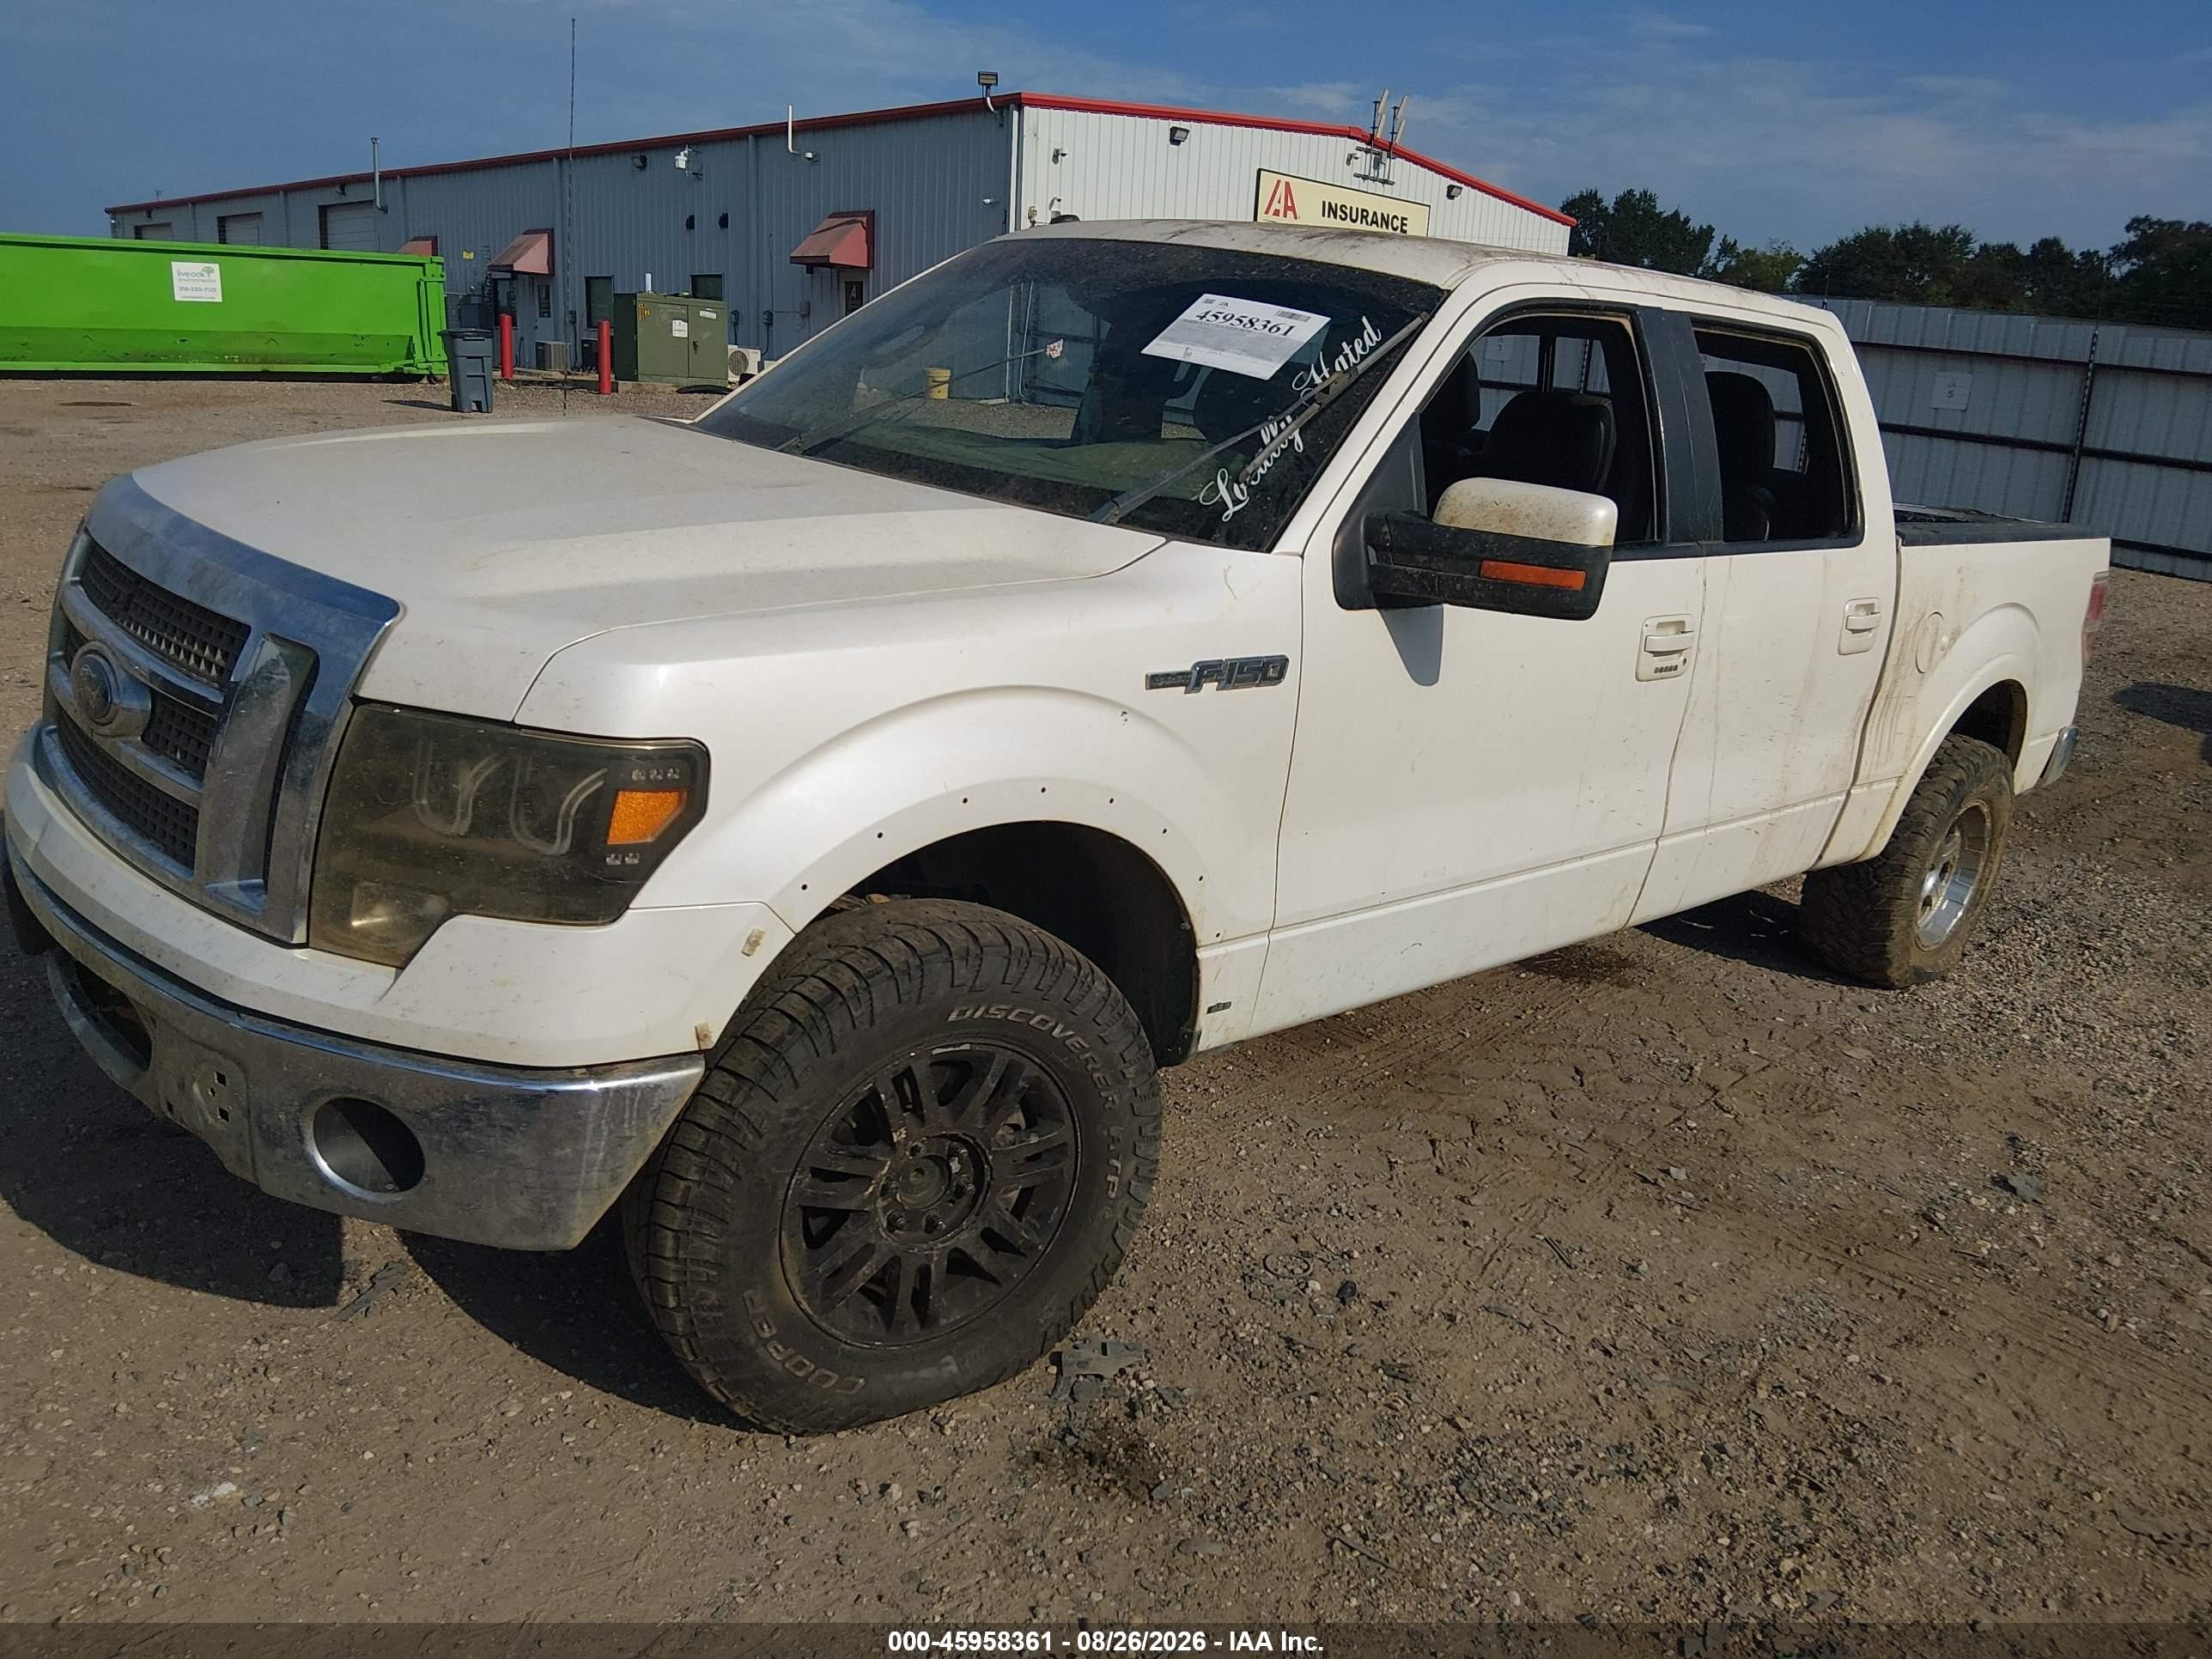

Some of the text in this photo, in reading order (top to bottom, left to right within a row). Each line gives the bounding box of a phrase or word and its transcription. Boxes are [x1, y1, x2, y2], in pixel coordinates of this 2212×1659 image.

[1322, 200, 1408, 234] INSURANCE
[1195, 309, 1296, 337] 45958361
[1292, 316, 1381, 405] Hated
[946, 1004, 1120, 1112] DISCOVERER
[743, 1289, 866, 1395] COOPER
